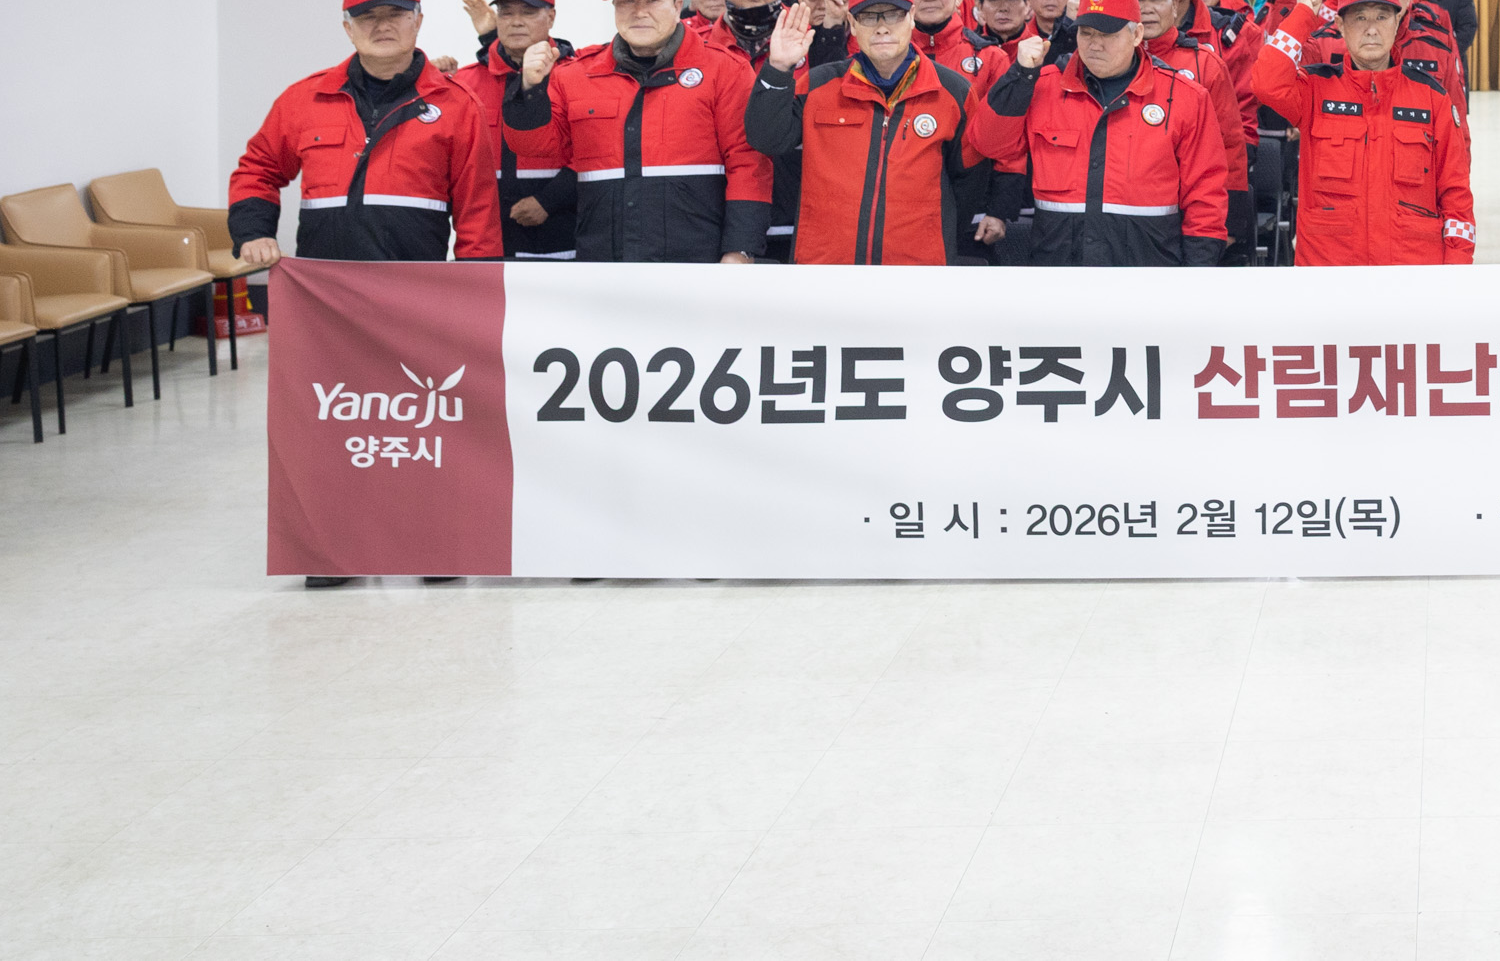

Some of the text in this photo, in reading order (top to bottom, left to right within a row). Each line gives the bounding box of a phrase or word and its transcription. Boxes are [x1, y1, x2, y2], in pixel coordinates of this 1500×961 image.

[1326, 101, 1358, 113] 양주시
[533, 346, 907, 424] 2026년도
[938, 346, 1161, 422] 양주시
[345, 436, 442, 468] 양주시
[889, 501, 925, 539] 일
[943, 501, 979, 540] 시
[1026, 500, 1158, 538] 2026년
[1176, 499, 1237, 538] 2월
[1254, 495, 1401, 540] 12일(목)
